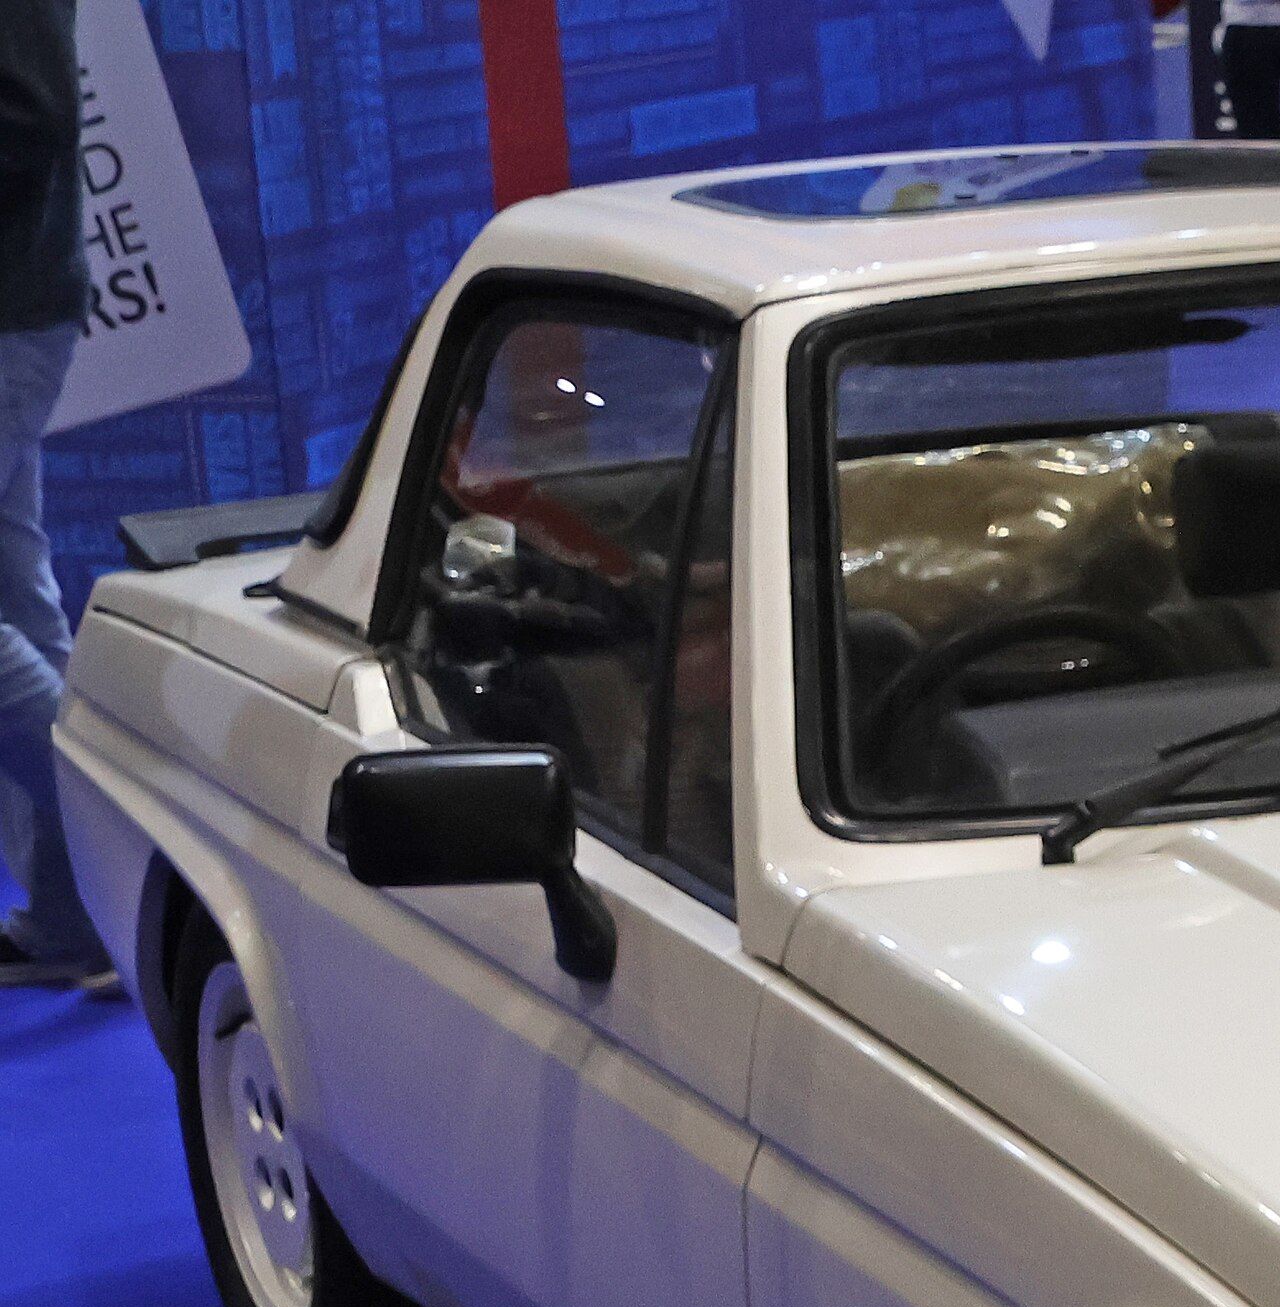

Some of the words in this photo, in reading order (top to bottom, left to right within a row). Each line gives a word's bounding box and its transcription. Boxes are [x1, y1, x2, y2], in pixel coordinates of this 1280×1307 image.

[79, 142, 123, 196] D
[85, 202, 148, 260] HE
[78, 260, 166, 339] RS!
